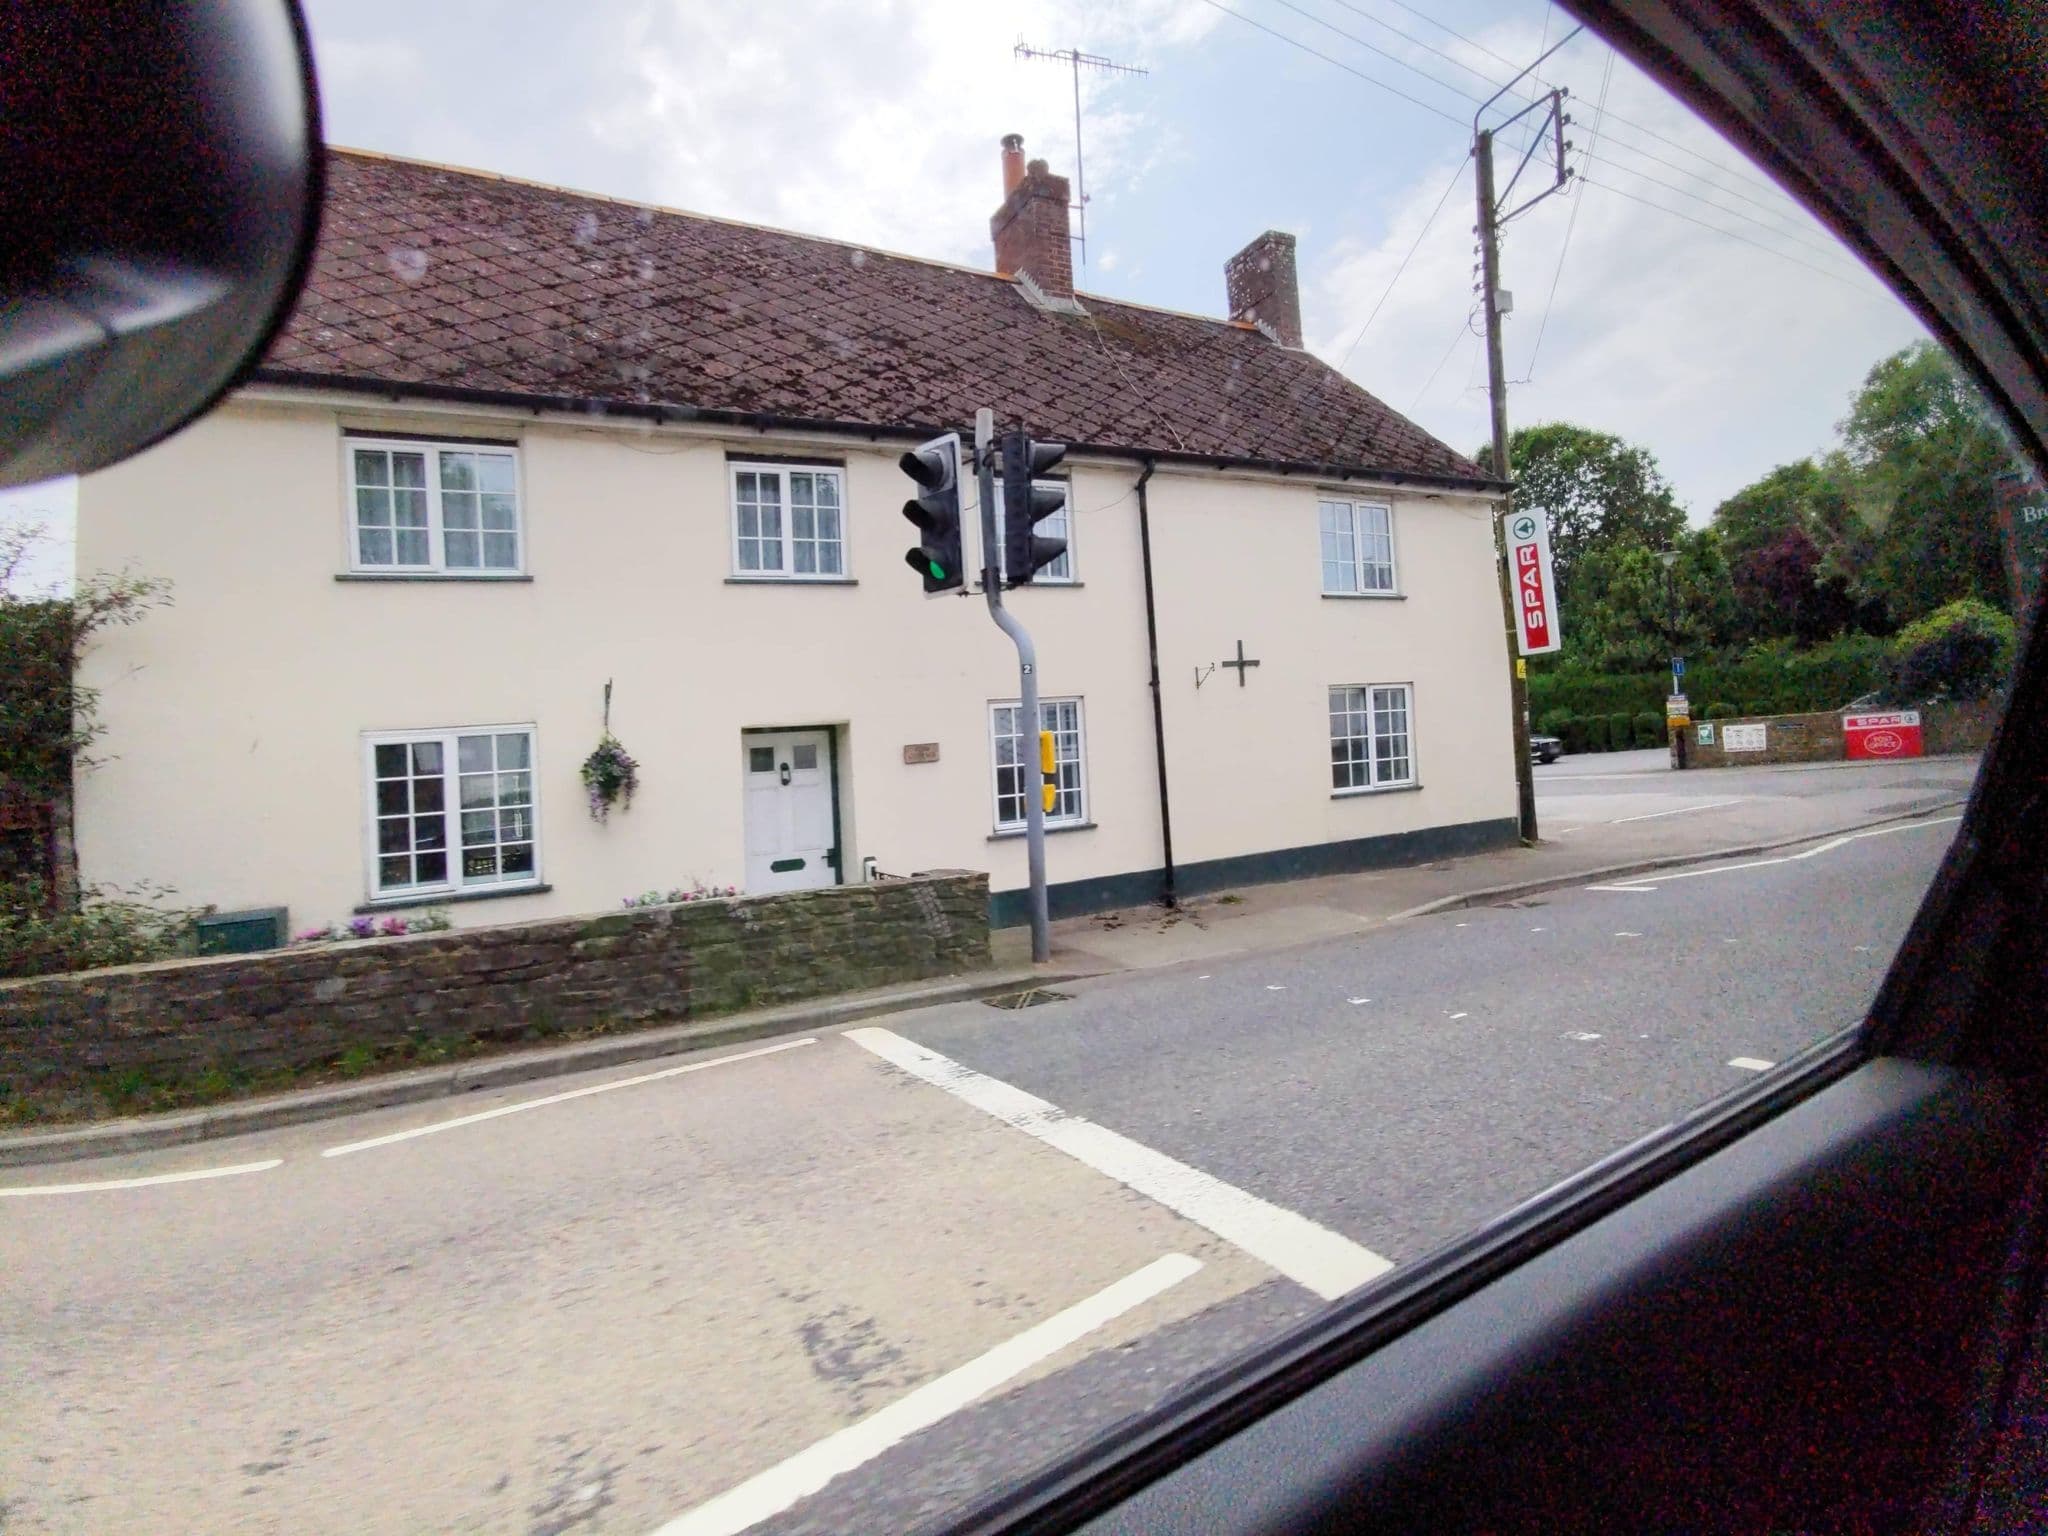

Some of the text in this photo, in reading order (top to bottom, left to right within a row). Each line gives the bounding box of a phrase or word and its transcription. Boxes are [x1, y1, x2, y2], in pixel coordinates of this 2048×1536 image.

[1520, 545, 1543, 629] SPAR
[1023, 664, 1031, 674] 2
[1857, 716, 1900, 726] SPAR
